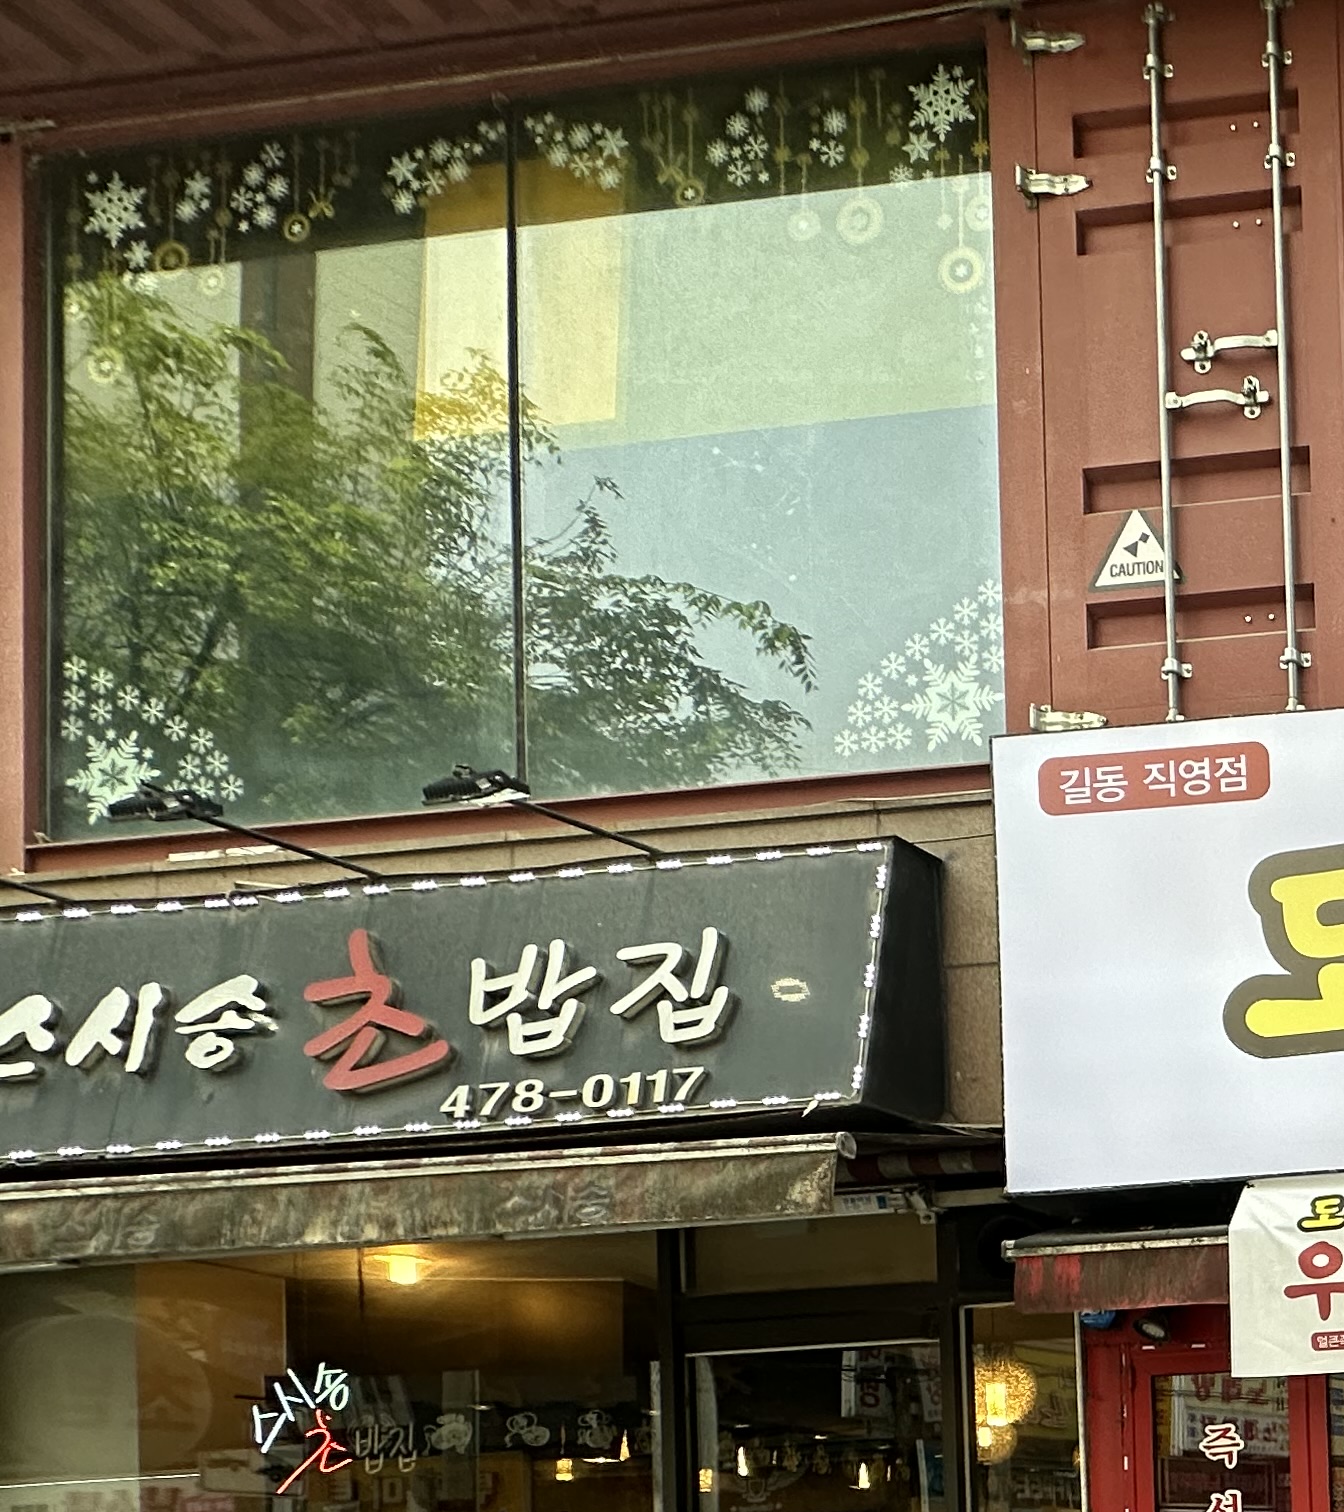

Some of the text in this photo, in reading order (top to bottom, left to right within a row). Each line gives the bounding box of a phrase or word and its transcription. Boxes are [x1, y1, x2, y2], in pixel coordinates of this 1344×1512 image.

[1110, 560, 1164, 577] CAUTION
[1059, 752, 1250, 805] 길동 직영점
[440, 1066, 706, 1121] 478-0117
